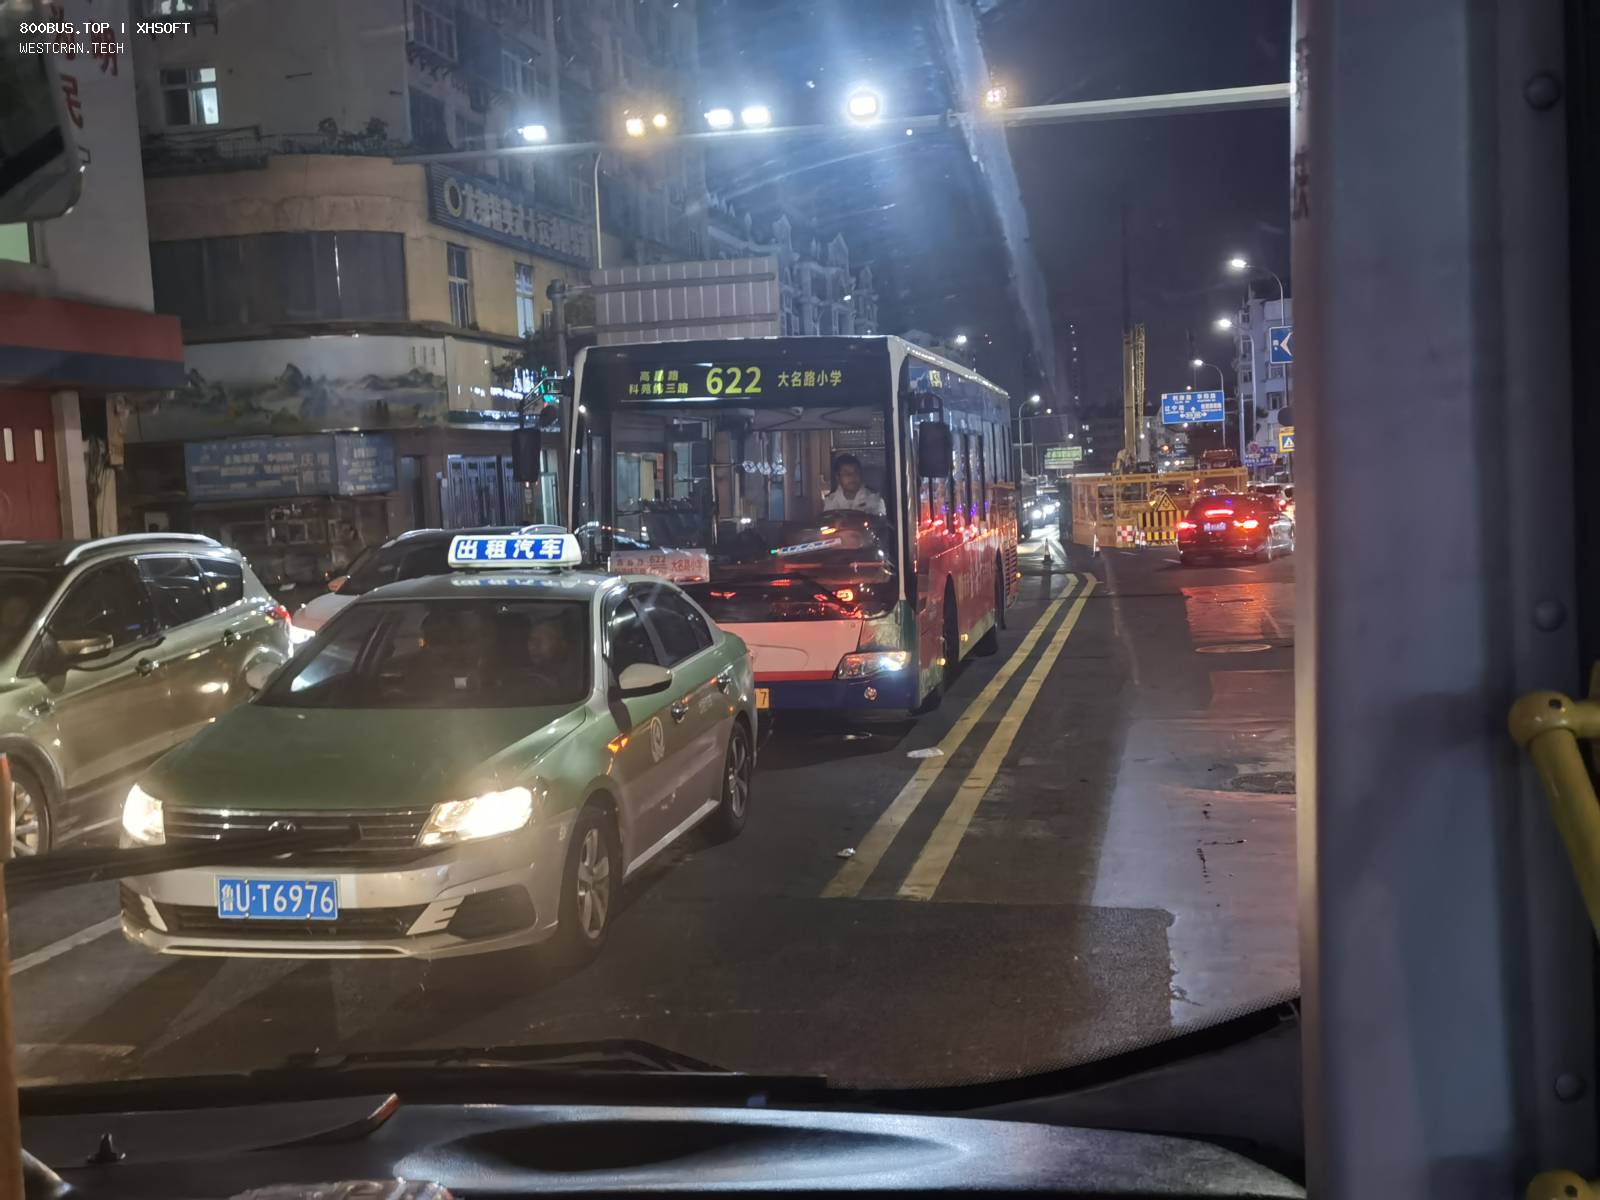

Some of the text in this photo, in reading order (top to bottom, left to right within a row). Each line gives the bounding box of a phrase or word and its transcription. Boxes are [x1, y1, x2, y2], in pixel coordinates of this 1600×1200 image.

[706, 366, 762, 395] 622
[777, 369, 842, 388] 大名路小学
[456, 539, 561, 560] 出租汽车
